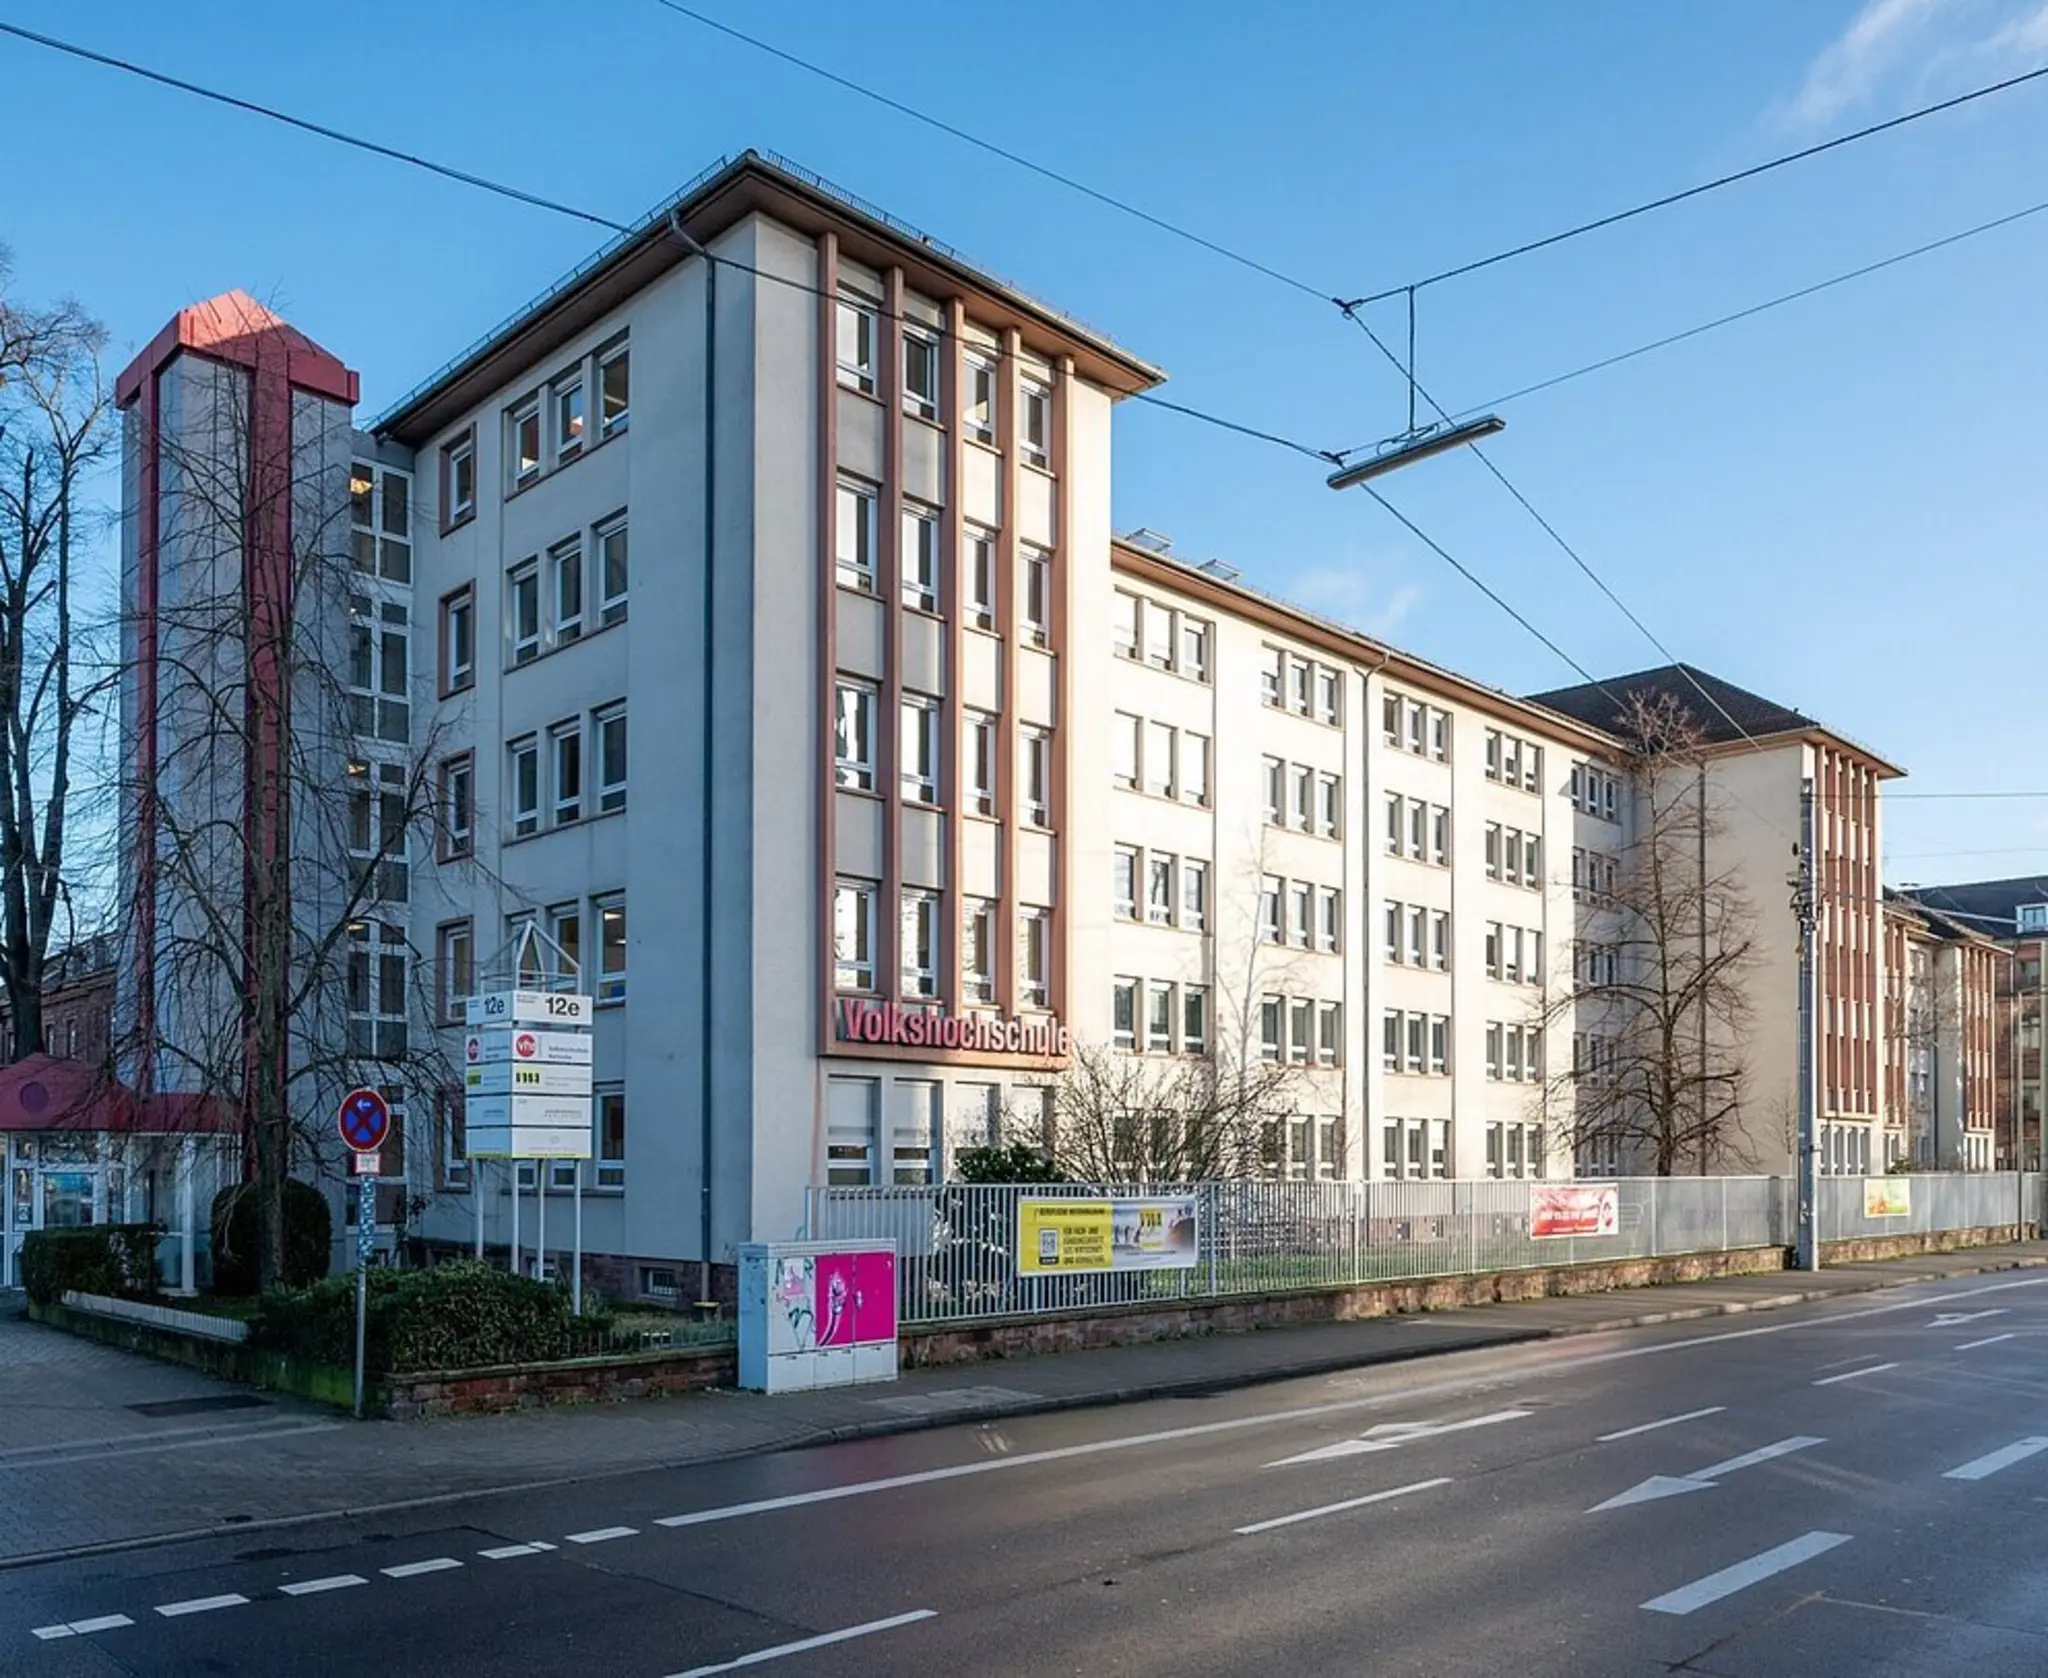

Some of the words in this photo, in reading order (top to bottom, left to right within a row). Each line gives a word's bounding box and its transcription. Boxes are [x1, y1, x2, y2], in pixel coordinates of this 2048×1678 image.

[484, 997, 505, 1015] 12e
[545, 997, 581, 1016] 12e
[844, 1000, 1071, 1056] Volkshochschule
